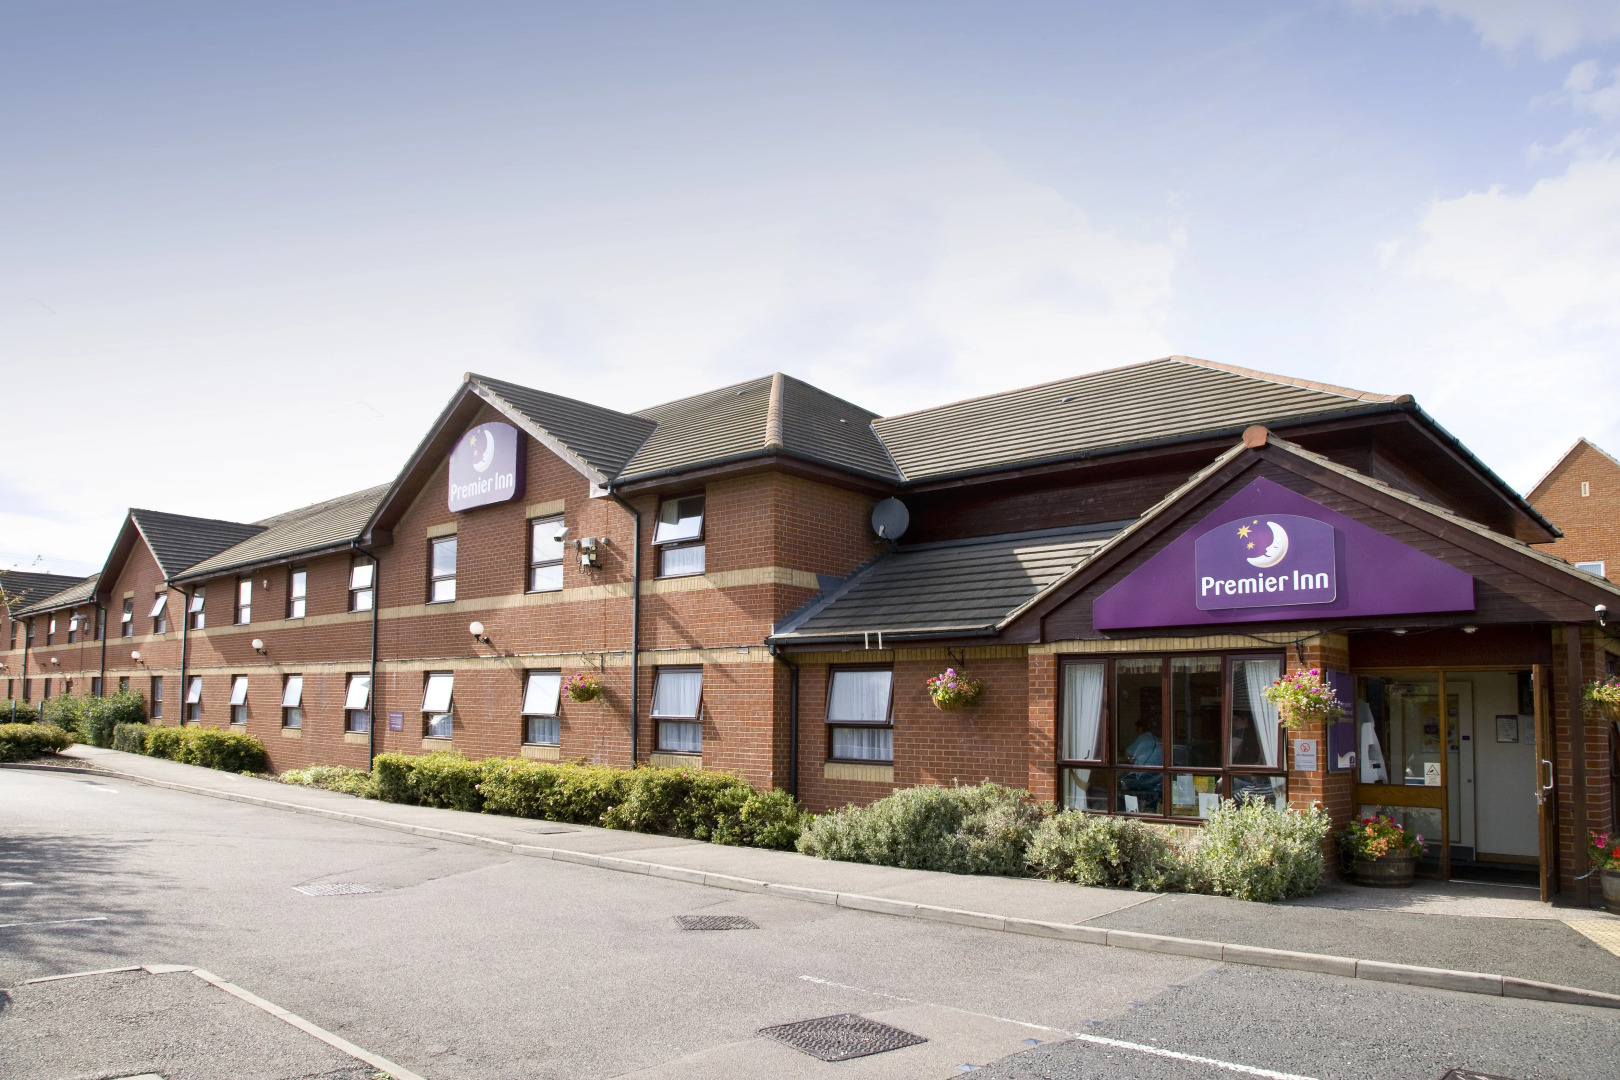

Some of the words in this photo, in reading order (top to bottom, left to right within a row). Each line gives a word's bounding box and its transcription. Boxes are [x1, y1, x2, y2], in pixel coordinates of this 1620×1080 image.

[451, 476, 493, 502] Premier
[495, 472, 513, 490] Inn
[1201, 572, 1289, 597] Premier
[1293, 570, 1329, 591] Inn
